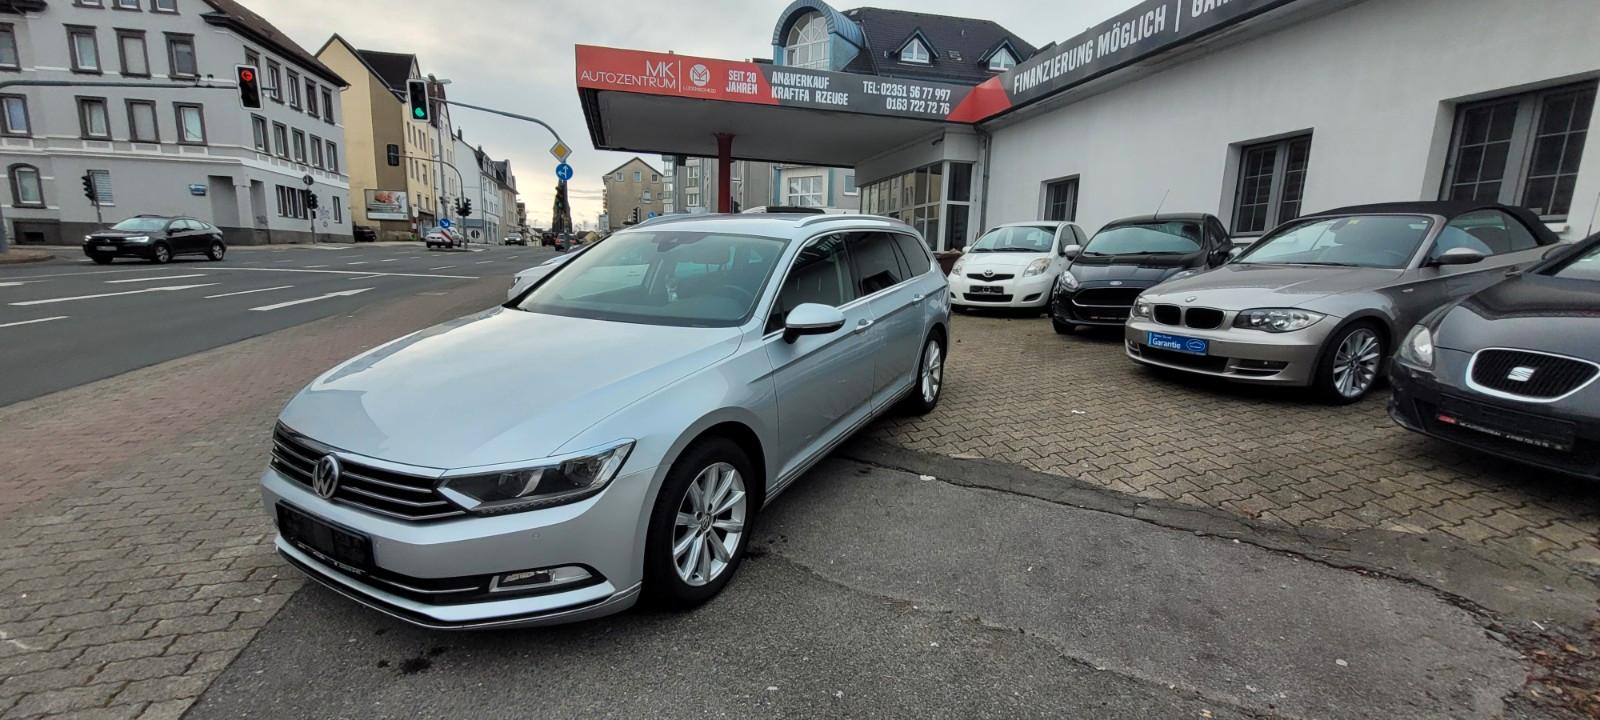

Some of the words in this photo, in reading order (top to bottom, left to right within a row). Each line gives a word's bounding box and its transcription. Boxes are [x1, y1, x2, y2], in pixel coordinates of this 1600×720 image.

[1013, 39, 1093, 95] FINANZIERUNG
[1096, 4, 1167, 58] MÖGLICH
[646, 59, 675, 78] MK
[728, 70, 745, 82] SEIT
[746, 71, 757, 83] 20
[580, 70, 676, 89] AUTOZENTRUM
[726, 81, 758, 95] JAHREN
[771, 71, 830, 90] AN&VERKAUF
[909, 85, 920, 97] 56
[922, 87, 933, 99] 77
[934, 88, 951, 102] 997
[886, 98, 907, 111] 0163
[909, 100, 925, 112] 722
[926, 101, 938, 114] 72
[939, 102, 950, 115] 76
[1152, 337, 1182, 349] Garantie
